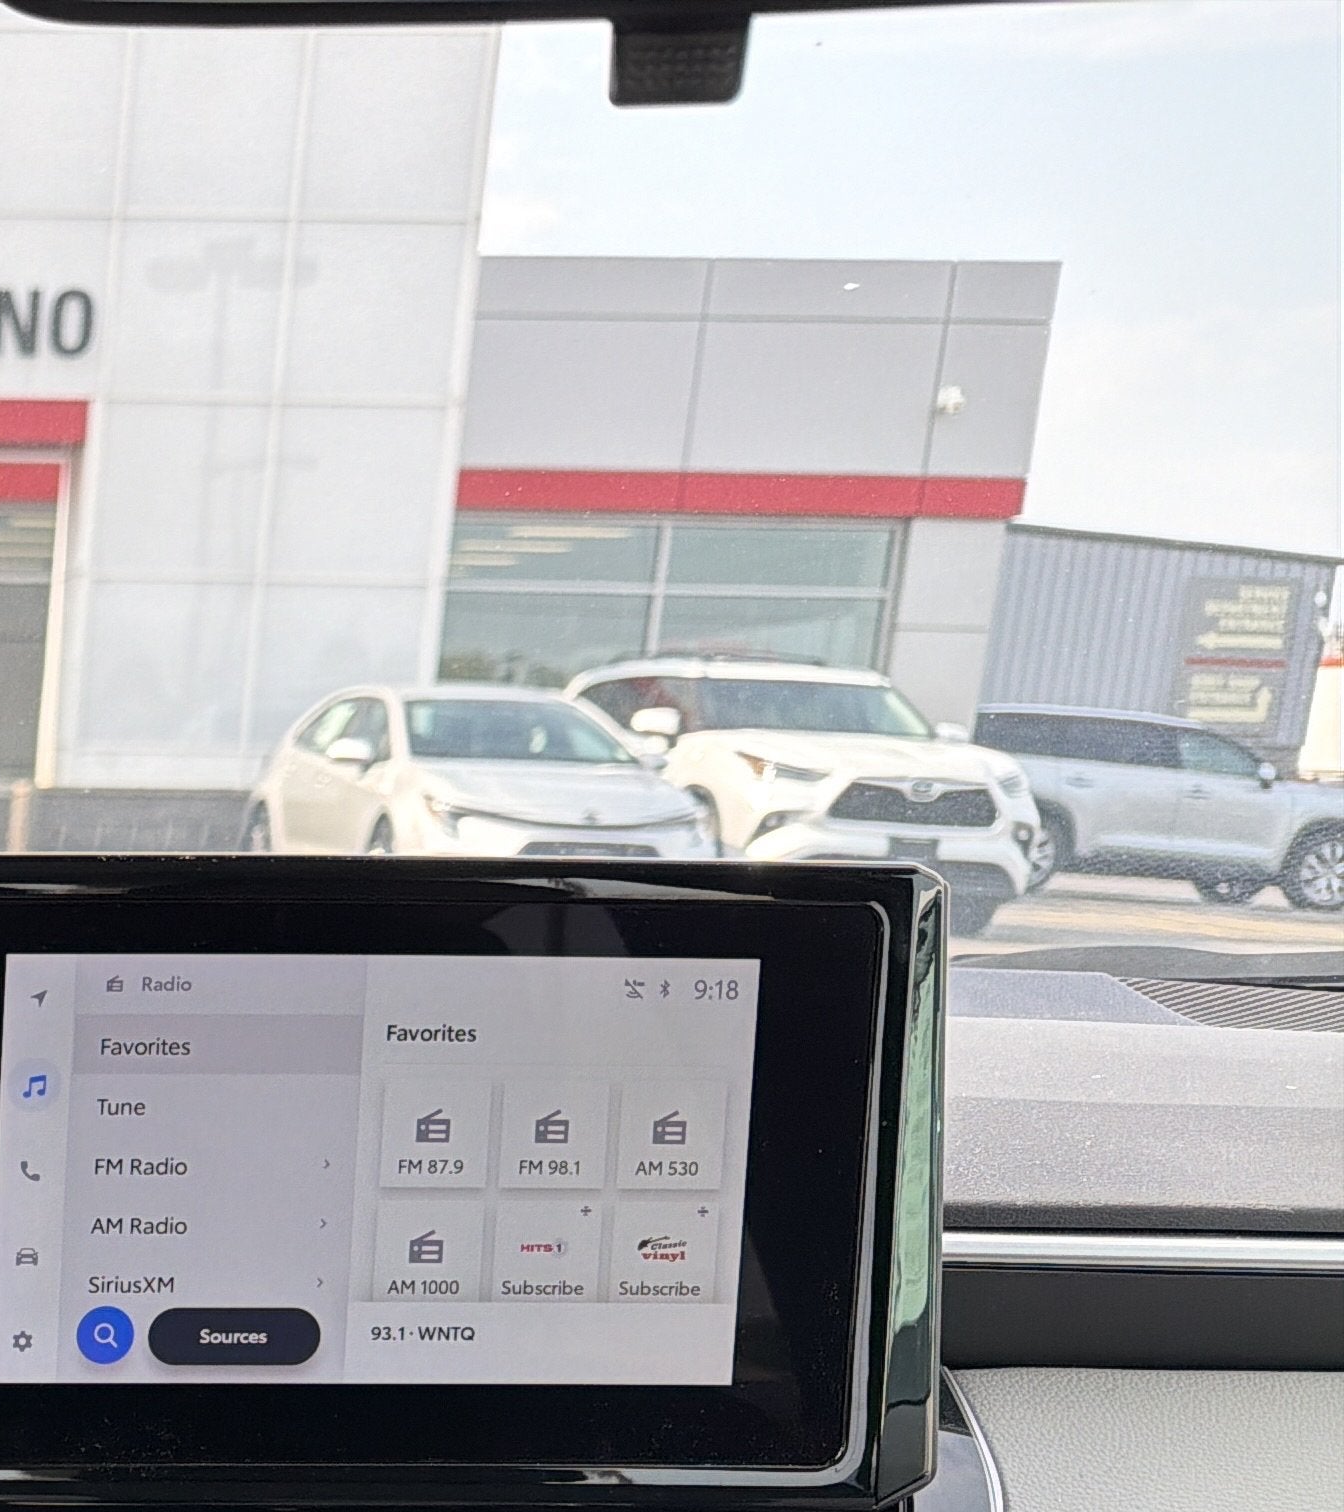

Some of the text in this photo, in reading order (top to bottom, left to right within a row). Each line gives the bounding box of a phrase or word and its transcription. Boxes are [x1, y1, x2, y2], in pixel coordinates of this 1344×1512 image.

[141, 976, 192, 992] Radio
[694, 979, 739, 1000] 9:18
[386, 1024, 477, 1043] Favorites
[100, 1038, 191, 1056] Favorites
[97, 1099, 146, 1116] Tune
[94, 1158, 188, 1176] FM Radio
[398, 1159, 464, 1174] FM 87.9
[519, 1160, 580, 1176] FM 98.1
[635, 1161, 699, 1176] AM 530
[91, 1217, 188, 1235] AM Radio
[520, 1244, 552, 1252] HITS
[650, 1240, 688, 1251] Classic
[641, 1251, 686, 1262] vinyl
[88, 1276, 175, 1294] SiriusXM
[387, 1280, 460, 1295] AM 1000
[501, 1280, 584, 1296] Subscribe
[618, 1281, 701, 1297] Subscribe
[199, 1329, 268, 1345] Sources
[370, 1326, 475, 1342] 93.1 WNTQ
